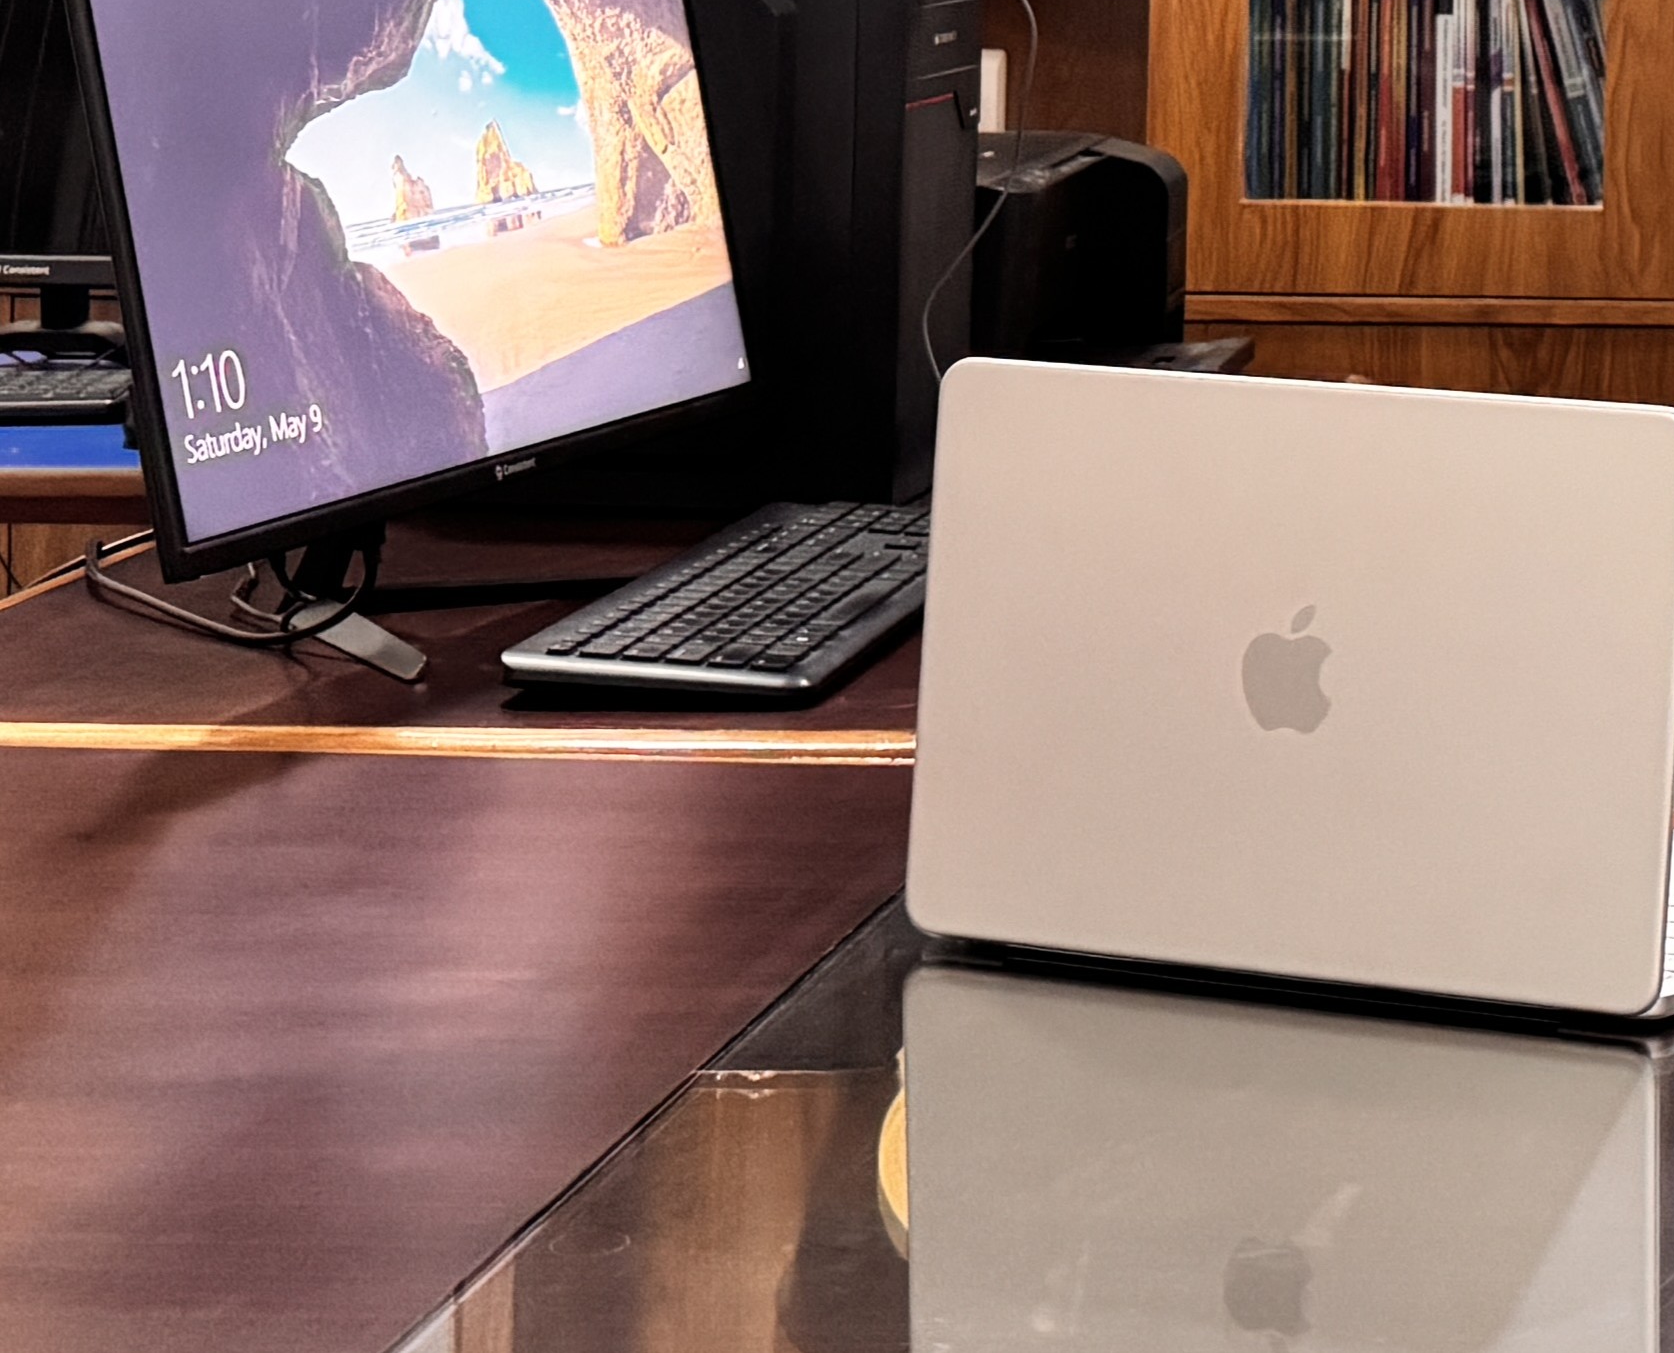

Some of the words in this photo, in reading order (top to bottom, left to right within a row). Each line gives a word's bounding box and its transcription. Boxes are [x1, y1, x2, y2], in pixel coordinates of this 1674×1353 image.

[172, 350, 245, 418] 1:10
[184, 421, 267, 464] Saturday,
[269, 412, 306, 444] May
[309, 404, 322, 433] 9
